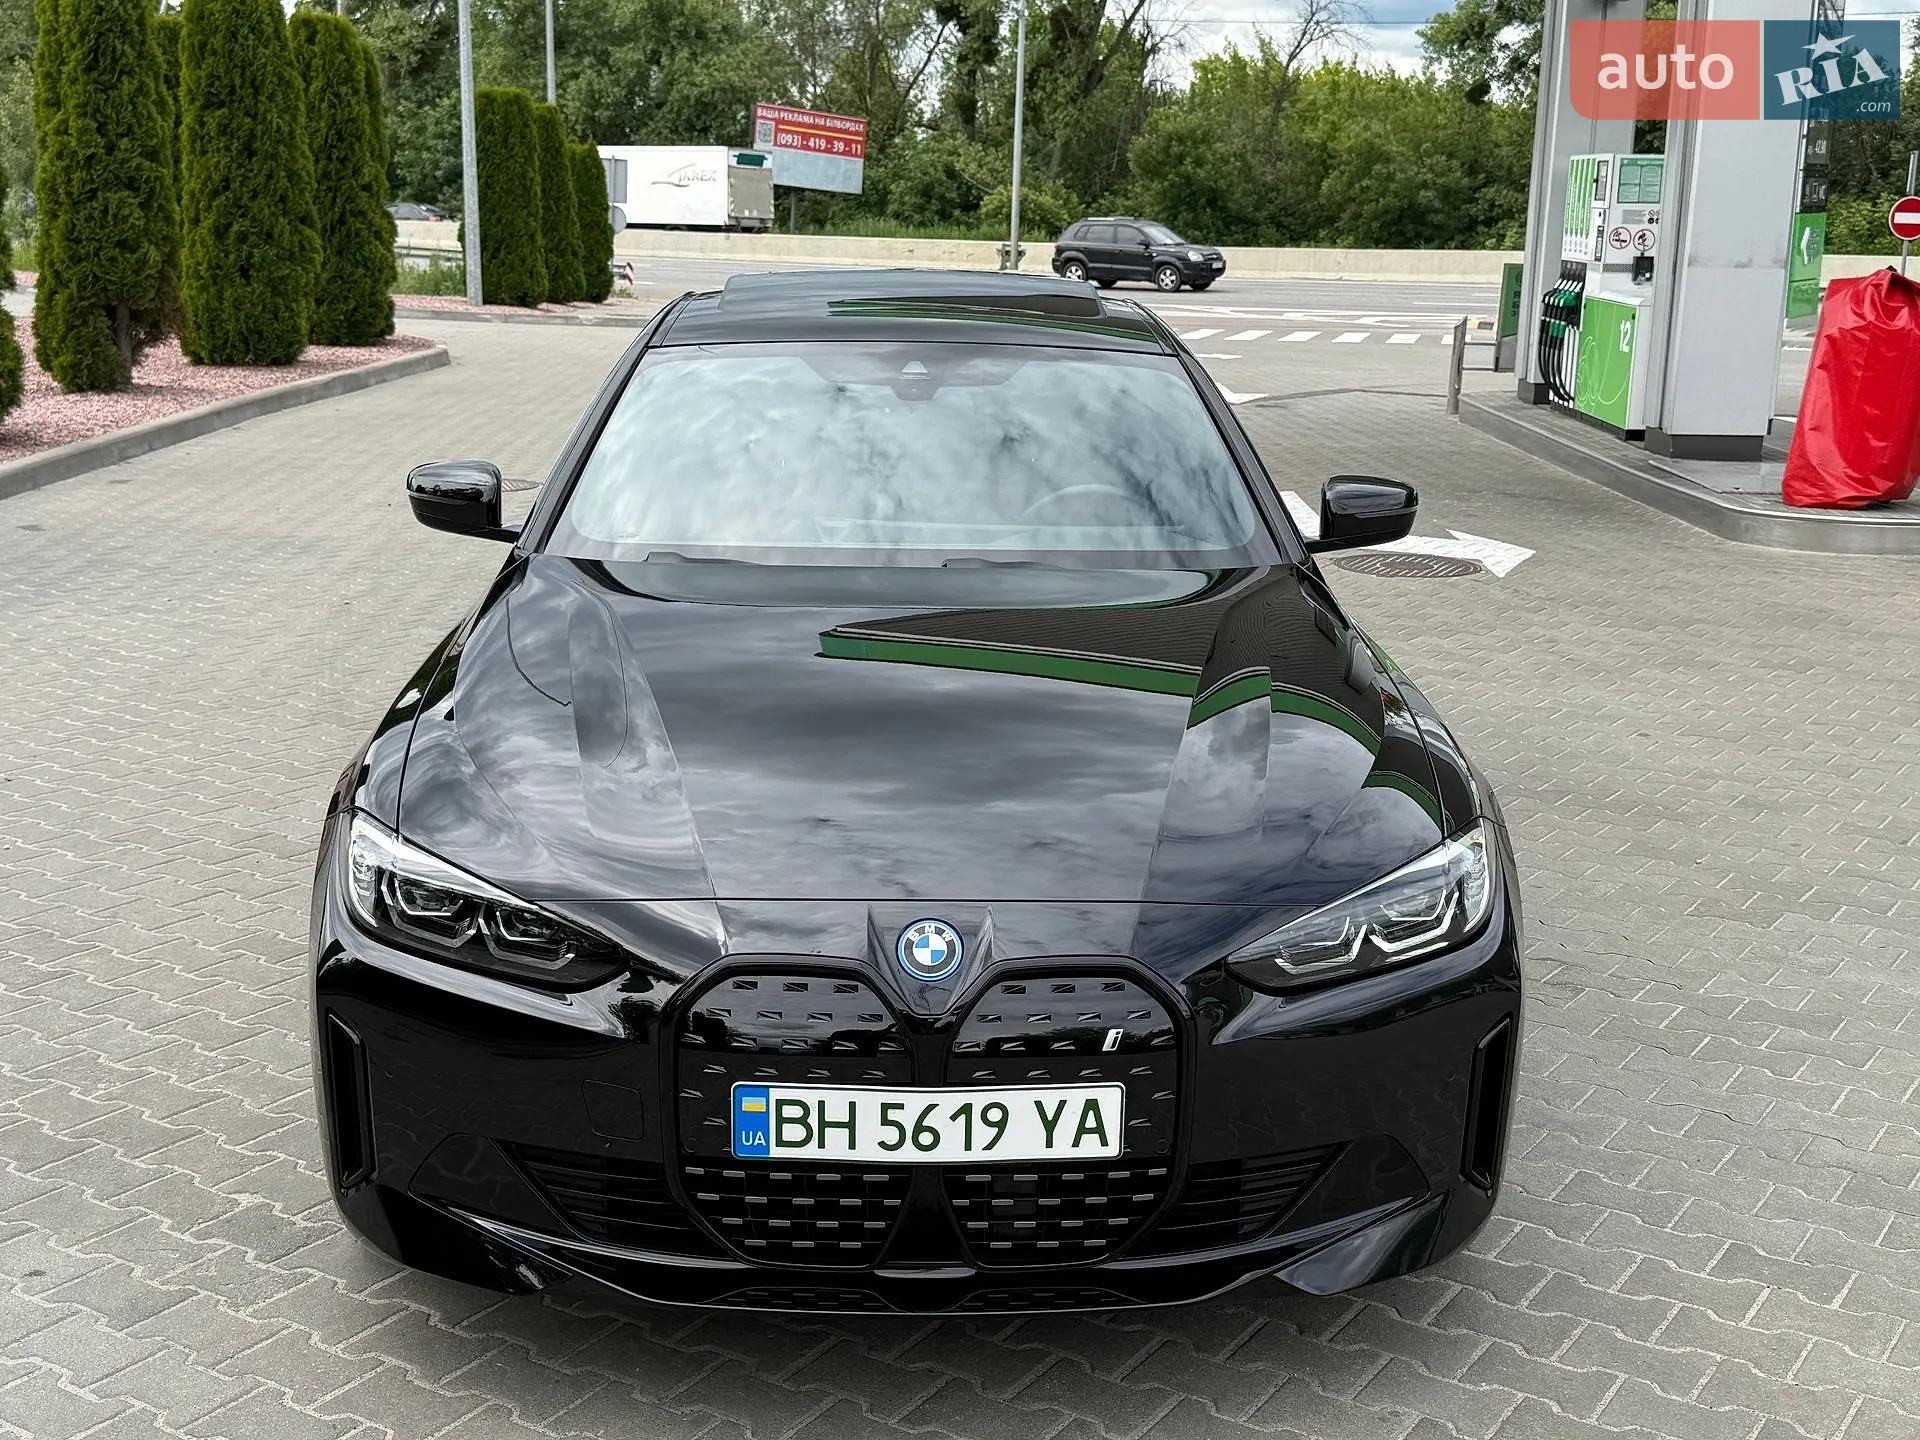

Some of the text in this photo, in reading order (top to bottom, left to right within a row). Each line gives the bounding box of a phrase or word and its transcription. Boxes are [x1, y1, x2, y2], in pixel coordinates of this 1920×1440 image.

[1619, 320, 1631, 353] 12
[908, 924, 953, 942] BMW
[774, 1098, 1109, 1152] BH 5619 YA
[742, 1131, 766, 1146] UA
